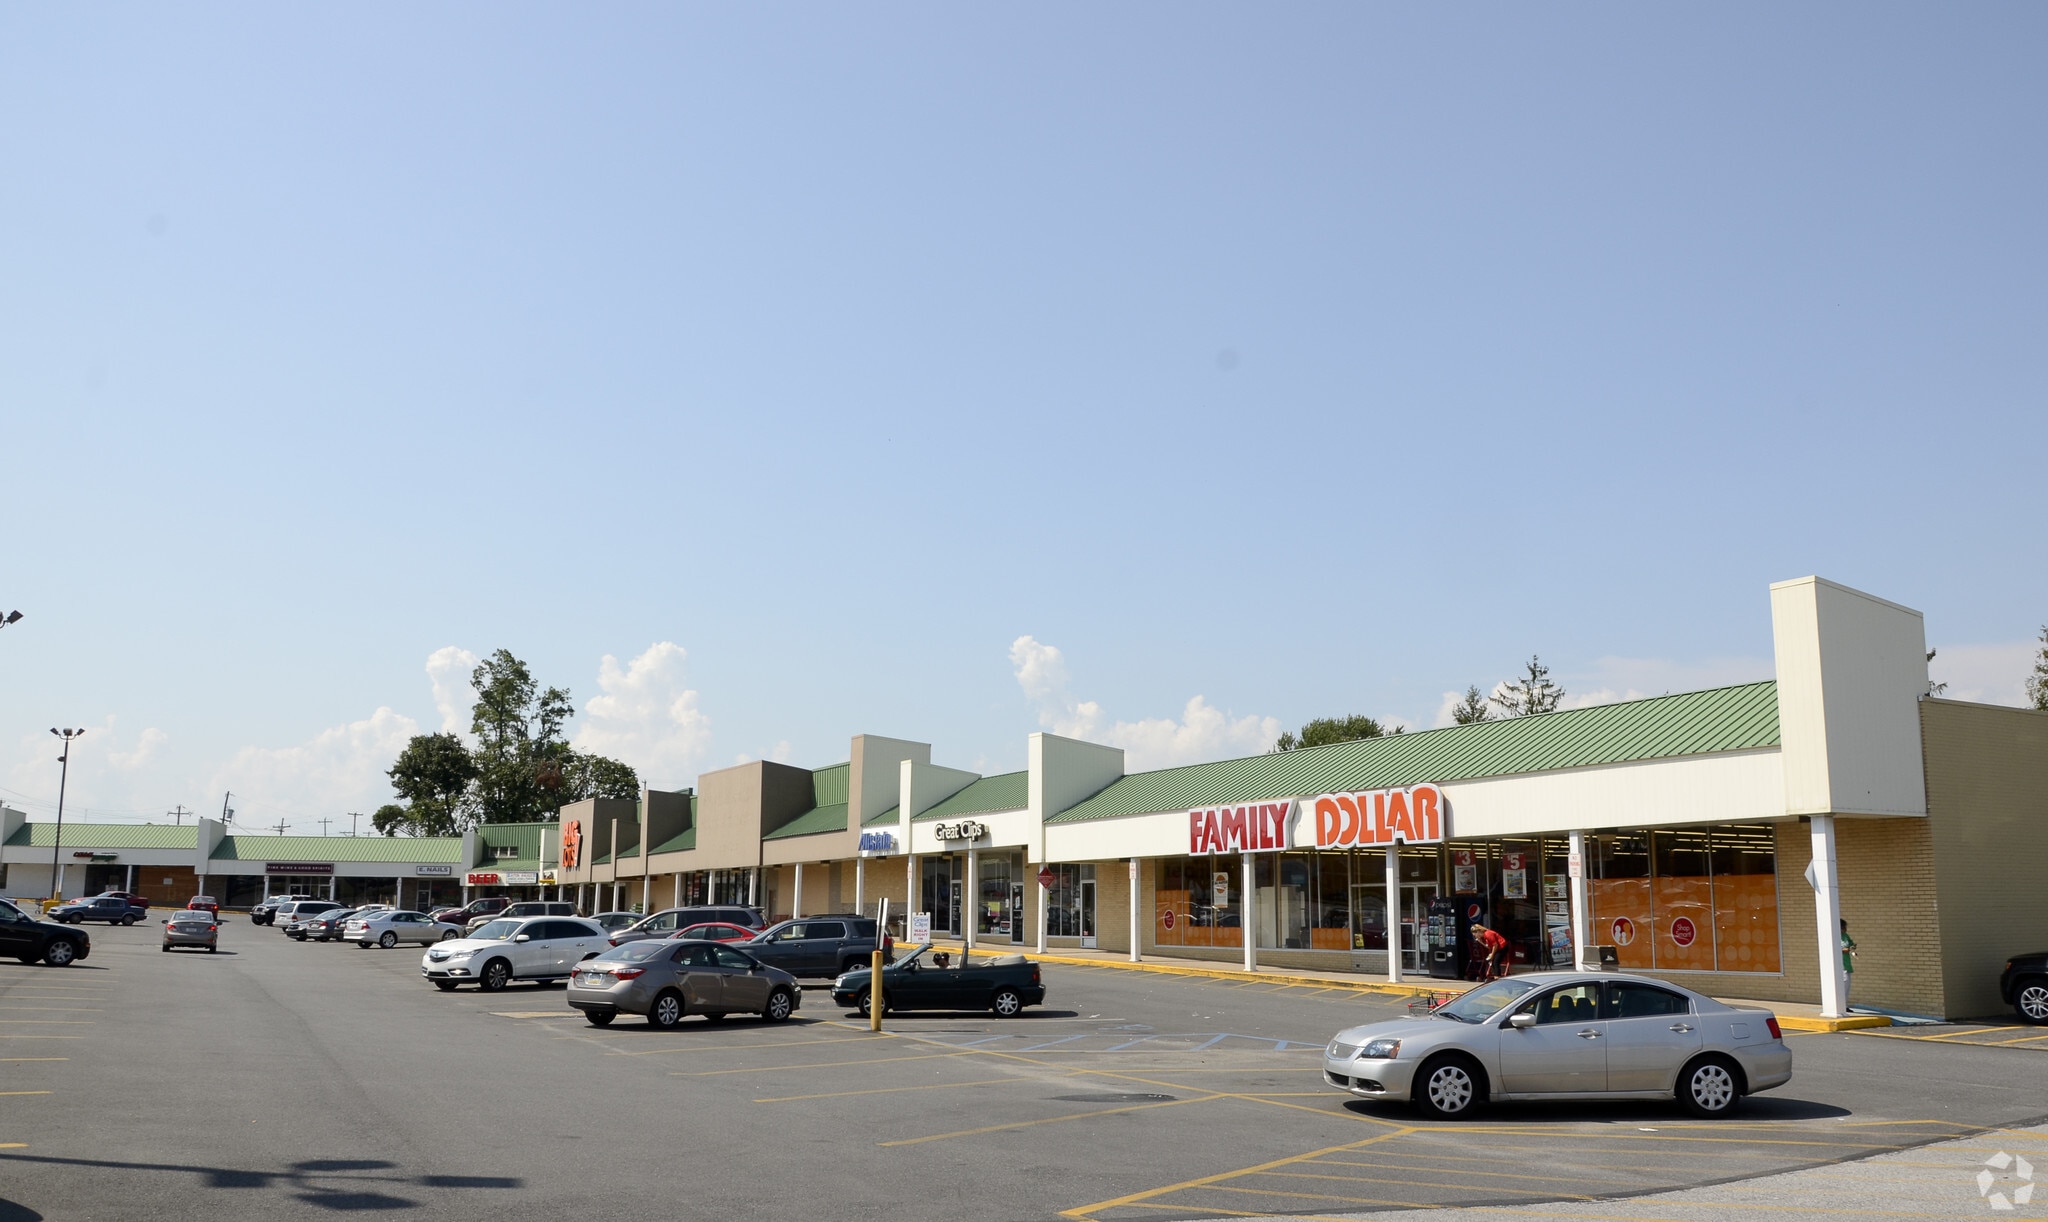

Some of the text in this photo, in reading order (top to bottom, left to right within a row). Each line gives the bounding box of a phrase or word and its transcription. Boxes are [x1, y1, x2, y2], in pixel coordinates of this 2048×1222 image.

[1190, 786, 1439, 853] FAMILY DOLLAR
[563, 820, 579, 846] BIG
[935, 820, 984, 841] Great Clips
[858, 832, 892, 851] Allstate
[467, 873, 499, 884] BEER
[1435, 901, 1452, 909] pepsi
[1676, 924, 1690, 932] Shop
